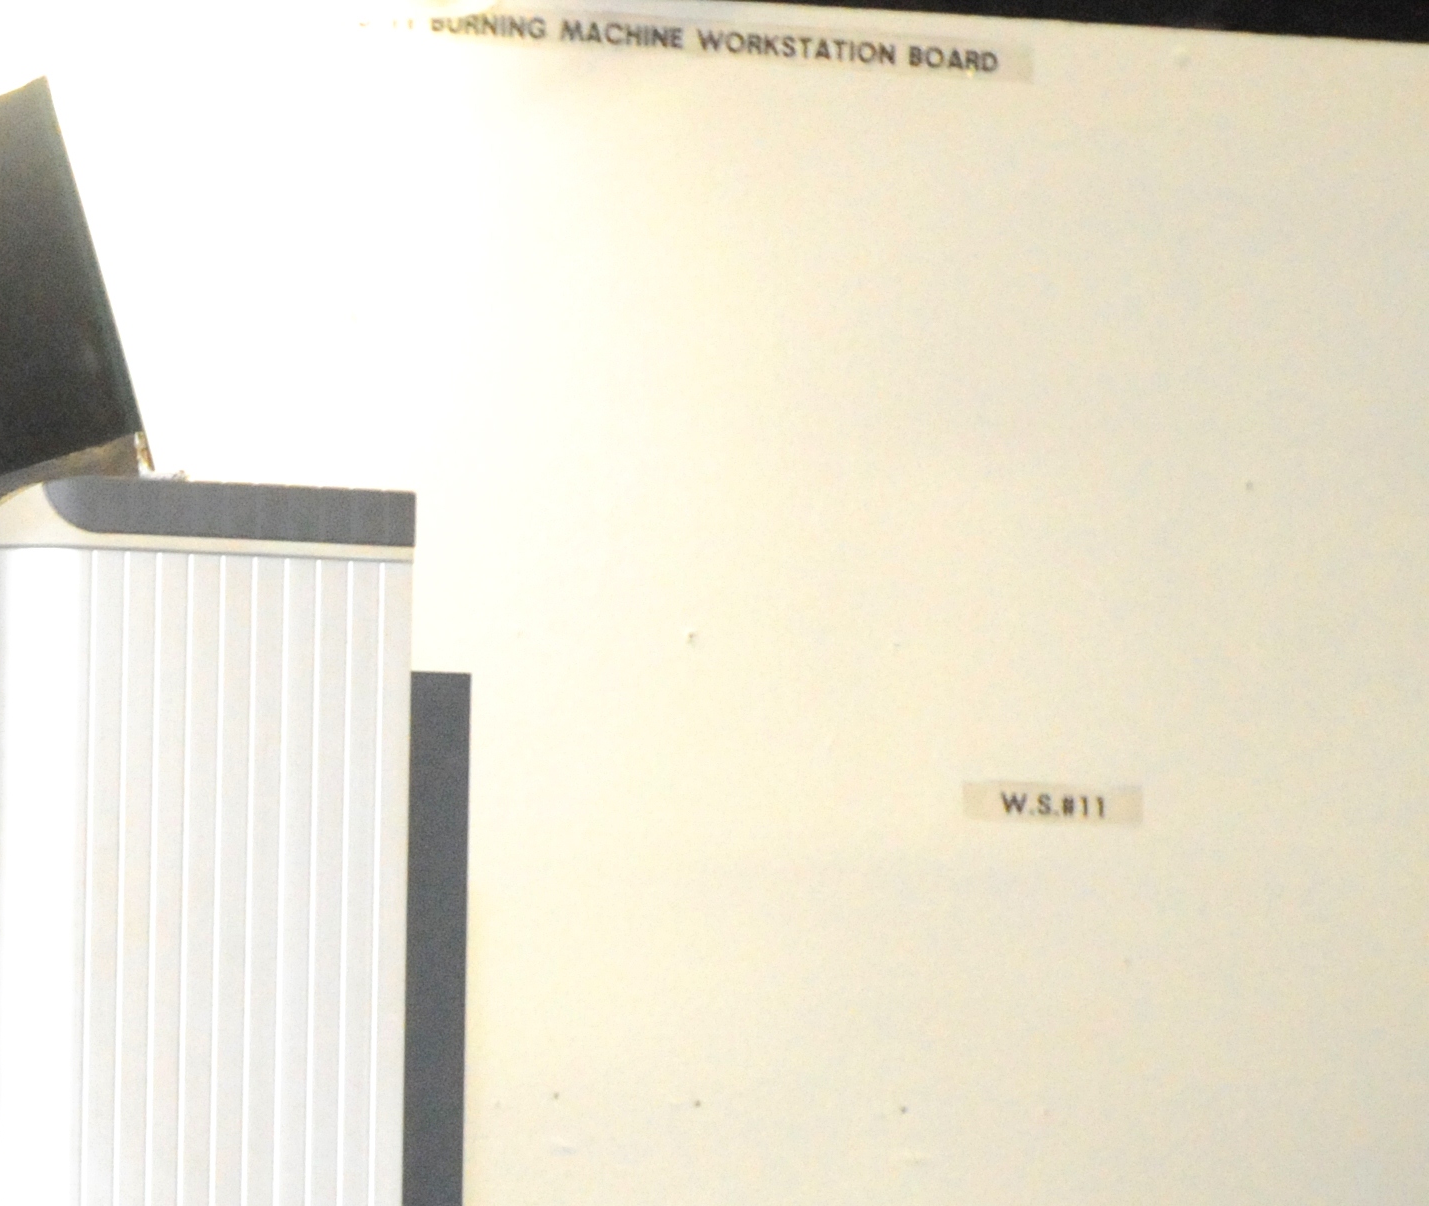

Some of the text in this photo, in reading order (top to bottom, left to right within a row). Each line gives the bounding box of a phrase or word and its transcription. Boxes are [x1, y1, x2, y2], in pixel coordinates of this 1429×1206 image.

[429, 13, 546, 40] BURNING
[559, 20, 684, 48] MACHINE
[696, 28, 896, 65] WORKSTATION
[907, 45, 999, 72] BOARD
